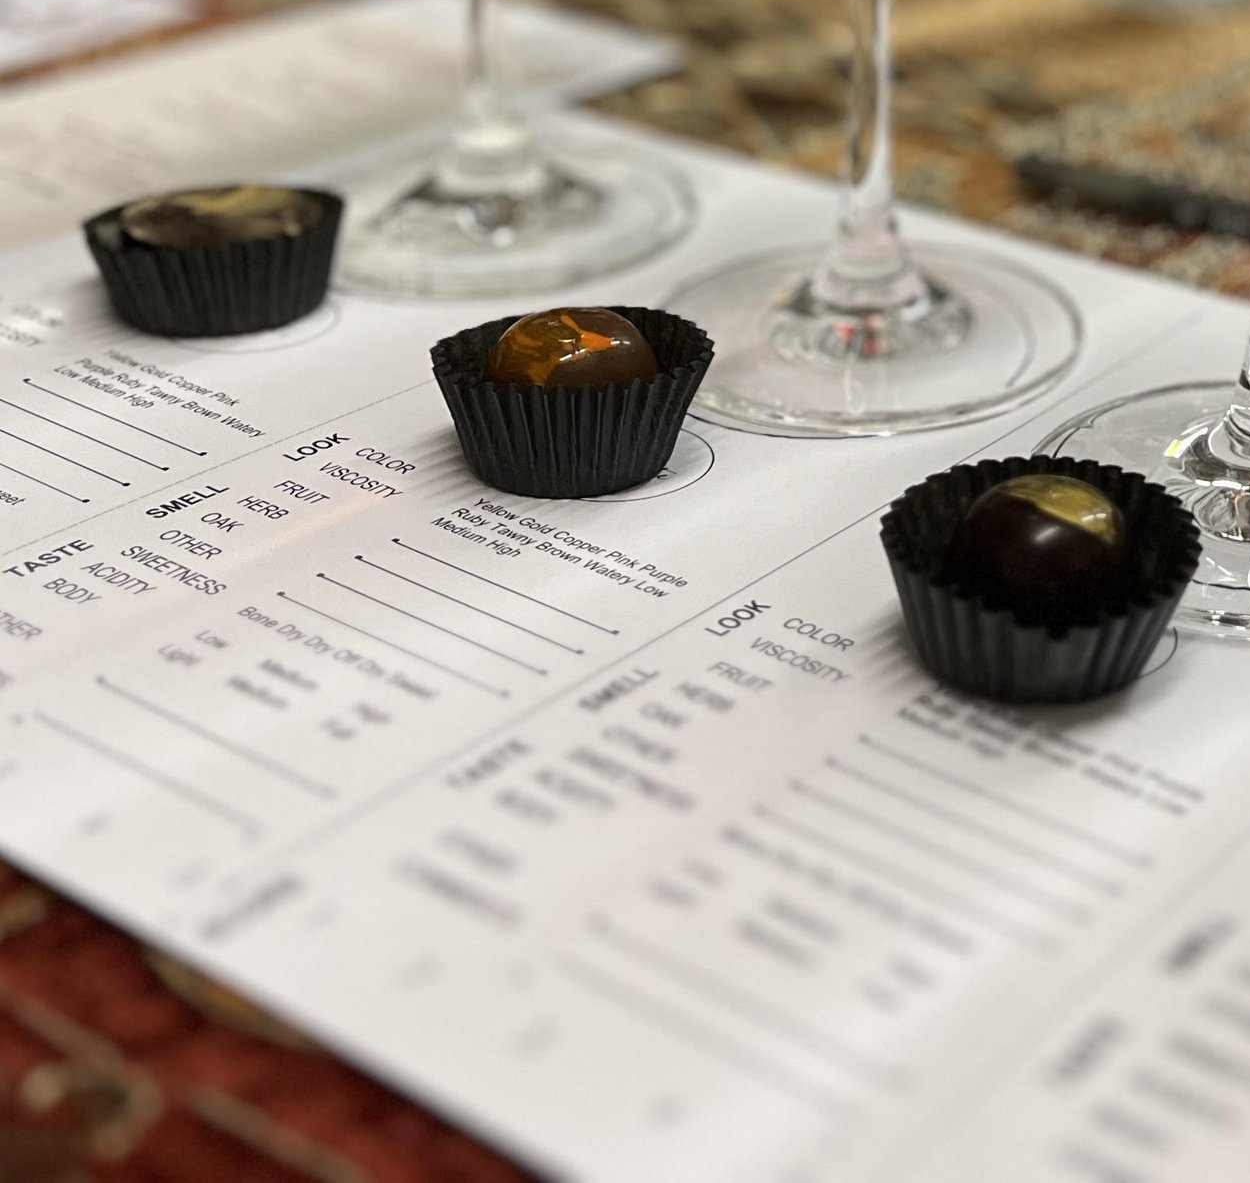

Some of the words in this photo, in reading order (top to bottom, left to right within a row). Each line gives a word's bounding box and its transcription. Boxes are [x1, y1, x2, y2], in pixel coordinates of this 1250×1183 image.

[54, 364, 82, 379] Low
[79, 374, 127, 397] Medium
[124, 392, 155, 409] High
[75, 357, 114, 376] Purple
[112, 372, 146, 389] Ruby
[145, 384, 185, 405] Tawny
[181, 400, 222, 420] Brown
[220, 415, 267, 438] Watery
[140, 364, 173, 378] Gold
[168, 375, 213, 396] Copper
[209, 391, 240, 407] Pink
[282, 432, 351, 462] LOOK
[355, 447, 416, 475] COLOR
[273, 480, 331, 504] FRUIT
[318, 461, 404, 499] VISCOSITY
[145, 484, 231, 519] SMELL
[236, 495, 290, 520] HERB
[199, 511, 245, 533] OAK
[430, 516, 487, 545] Medium
[485, 536, 522, 558] High
[2, 538, 95, 578] TASTE
[158, 529, 223, 561] OTHER
[451, 507, 492, 530] Ruby
[490, 522, 539, 547] Tawny
[534, 541, 583, 565] Brown
[583, 559, 637, 587] Watery
[633, 579, 671, 599] Low
[473, 497, 520, 522] Yellow
[518, 516, 552, 535] Gold
[553, 530, 607, 557] Copper
[604, 550, 641, 570] Pink
[637, 563, 689, 589] Purple
[80, 561, 158, 595] ACIDITY
[120, 544, 228, 596] SWEETNESS
[42, 577, 103, 605] BODY
[0, 611, 43, 642] THER
[236, 605, 280, 629] Bone
[275, 623, 307, 643] Dry
[303, 636, 335, 655] Dry
[704, 599, 772, 637] LOOK
[783, 617, 855, 652] COLOR
[194, 629, 231, 651] Low
[707, 660, 775, 692] FRUIT
[749, 636, 853, 683] VISCOSITY
